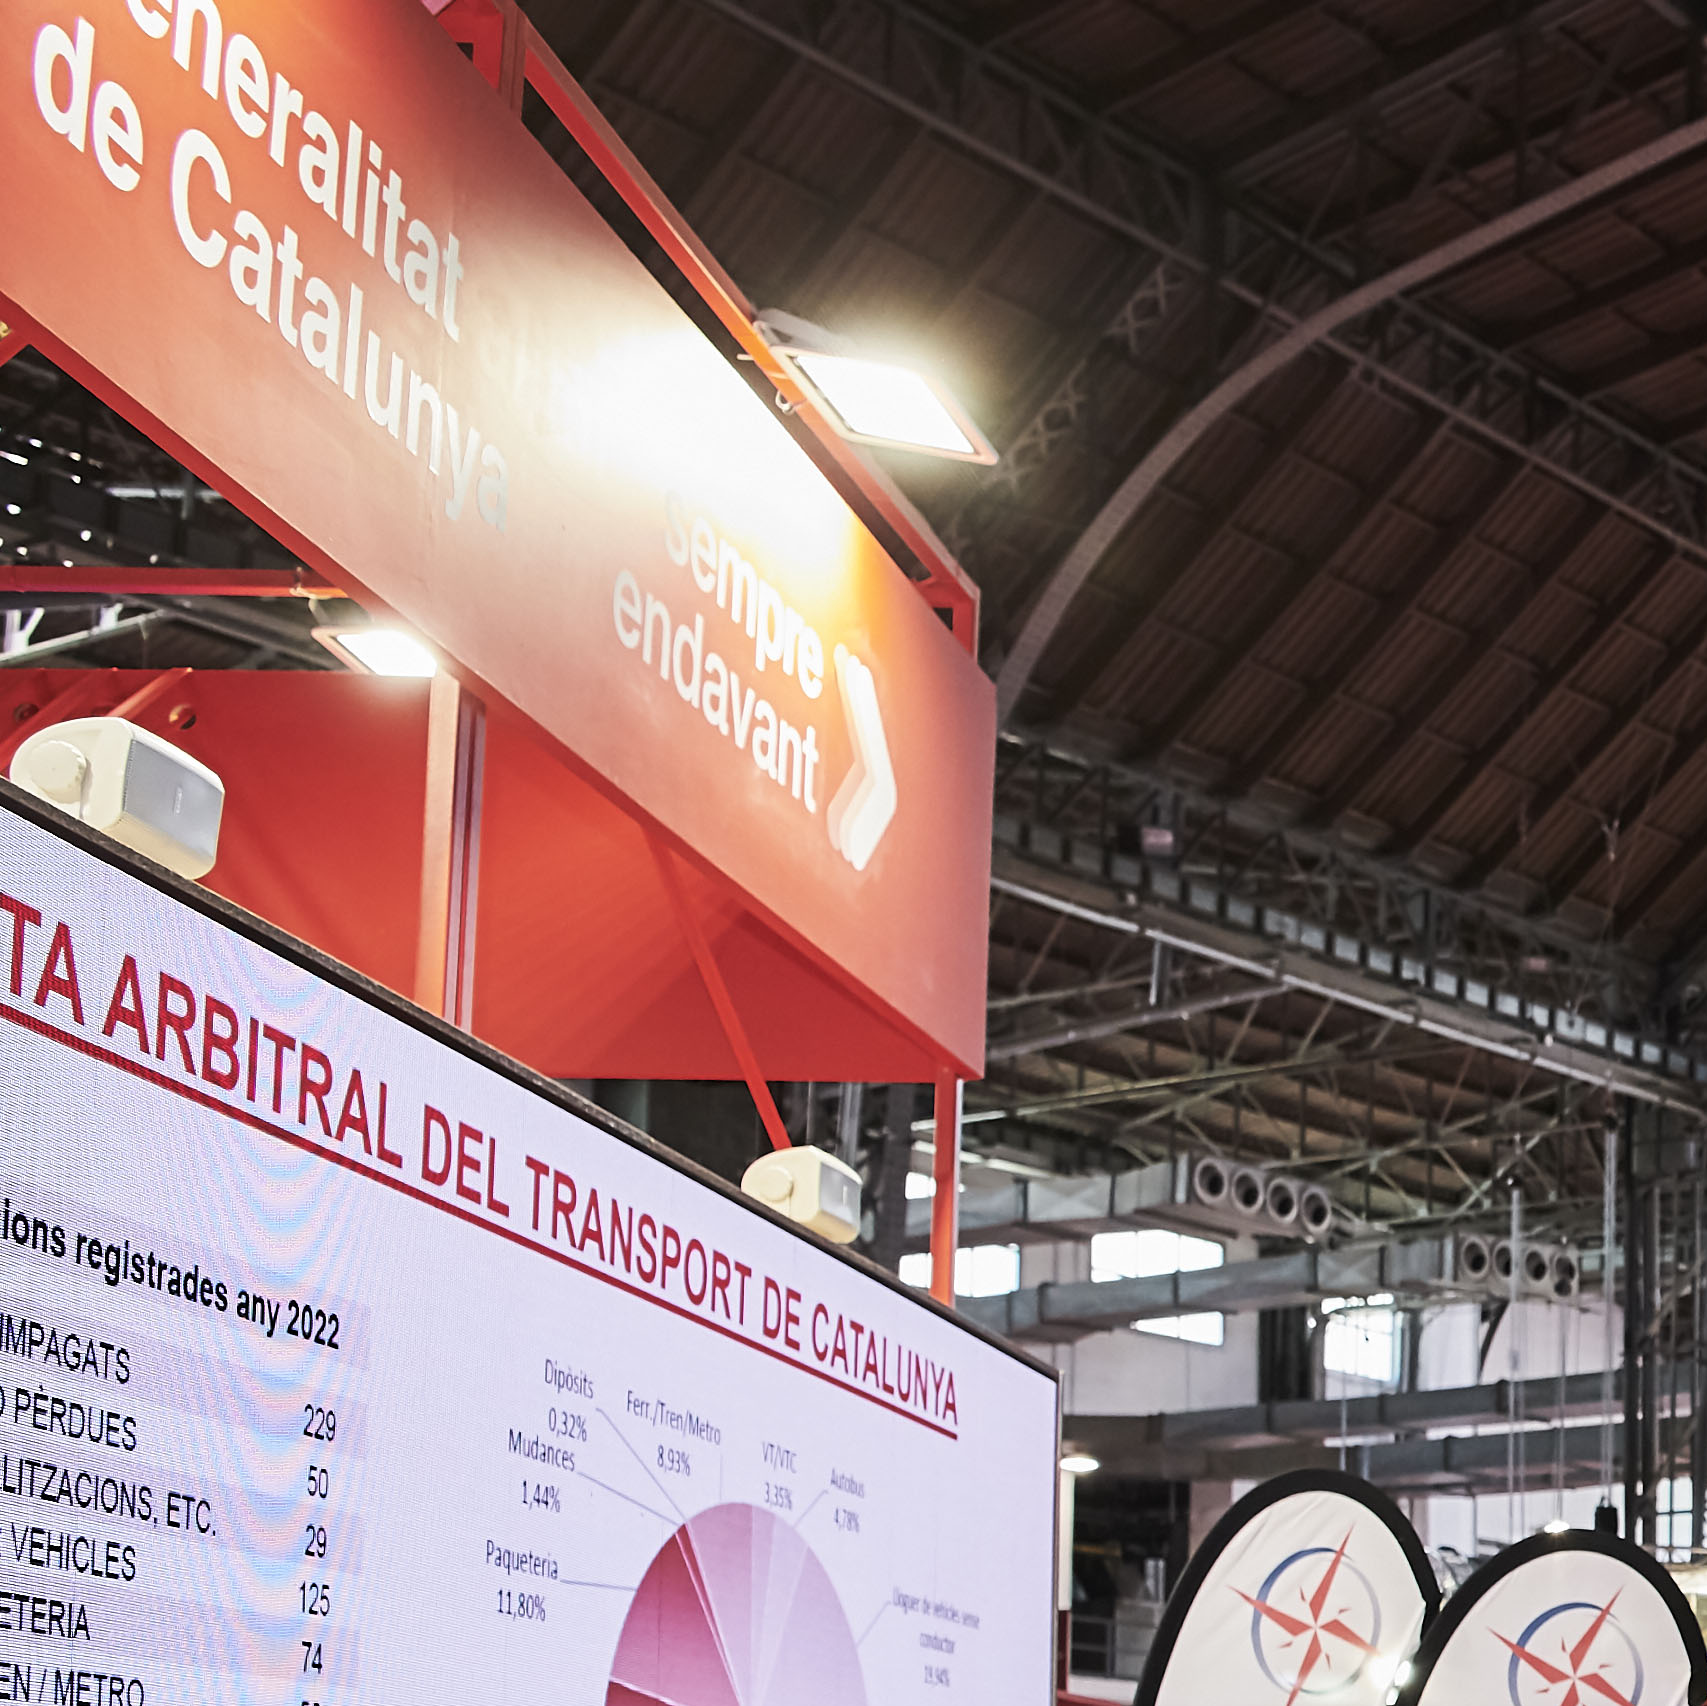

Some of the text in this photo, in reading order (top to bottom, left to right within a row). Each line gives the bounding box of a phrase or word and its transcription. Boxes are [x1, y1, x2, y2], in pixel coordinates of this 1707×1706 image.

[32, 16, 509, 532] de Catalunya
[665, 490, 825, 700] sempre
[613, 568, 820, 814] endavant
[0, 891, 958, 1426] TA ARBITRAL DEL TRANSPORT DE CATALUNYA
[75, 1231, 229, 1313] registrades
[236, 1287, 281, 1338] any
[286, 1299, 340, 1350] 2022
[544, 1358, 596, 1401] Dipòsits
[14, 1383, 138, 1452] PÈRDUES
[302, 1402, 337, 1442] 229
[548, 1406, 588, 1443] 0,32%
[626, 1388, 722, 1446] Ferr./Tren/Metro
[507, 1427, 576, 1473] Mudances
[656, 1443, 691, 1478] 8,93%
[166, 1492, 218, 1537] ETC.
[307, 1464, 330, 1500] 50
[521, 1479, 561, 1514] 1,44%
[763, 1481, 793, 1513] 3,35%
[11, 1521, 328, 1582] VEHICLES 29
[486, 1538, 560, 1582] Paqueteria
[299, 1580, 331, 1617] 125
[496, 1587, 547, 1622] 11,80%
[301, 1640, 324, 1675] 74
